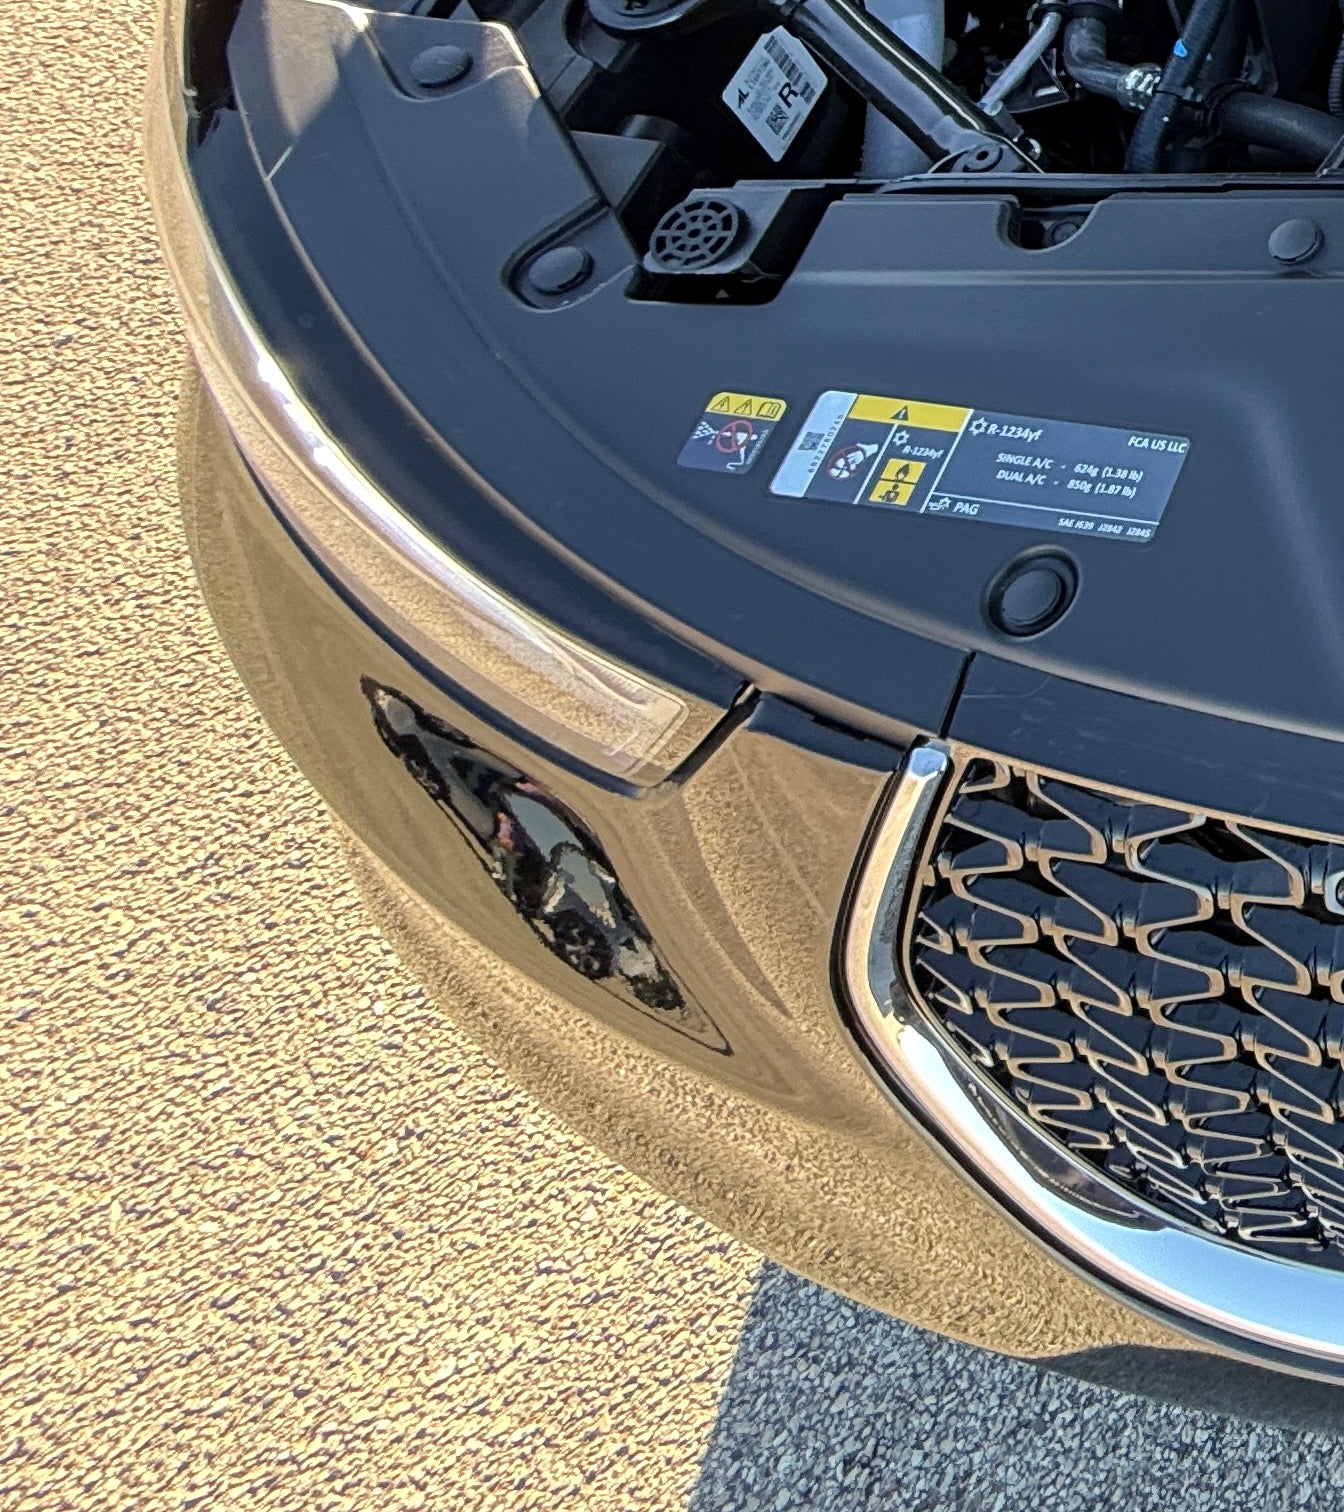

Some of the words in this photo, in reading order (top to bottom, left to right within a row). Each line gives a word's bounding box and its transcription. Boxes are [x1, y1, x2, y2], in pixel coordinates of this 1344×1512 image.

[778, 82, 798, 109] R
[987, 423, 1043, 443] R-1234yf
[902, 445, 945, 460] R-1234yf
[1127, 436, 1150, 450] FCA
[1151, 438, 1166, 451] US
[1167, 440, 1187, 454] LLC
[995, 452, 1033, 468] SINGLE
[1032, 457, 1054, 470] A/C
[1073, 462, 1099, 478] 624g
[1101, 465, 1128, 480] (1.38
[1128, 469, 1144, 483] lb)
[996, 469, 1025, 483] DUAL
[1024, 473, 1047, 486] A/C
[1067, 479, 1093, 494] 850g
[1094, 482, 1121, 496] (1.87
[1121, 486, 1136, 499] lb)
[952, 501, 980, 515] PAG
[1058, 518, 1075, 528] SAE
